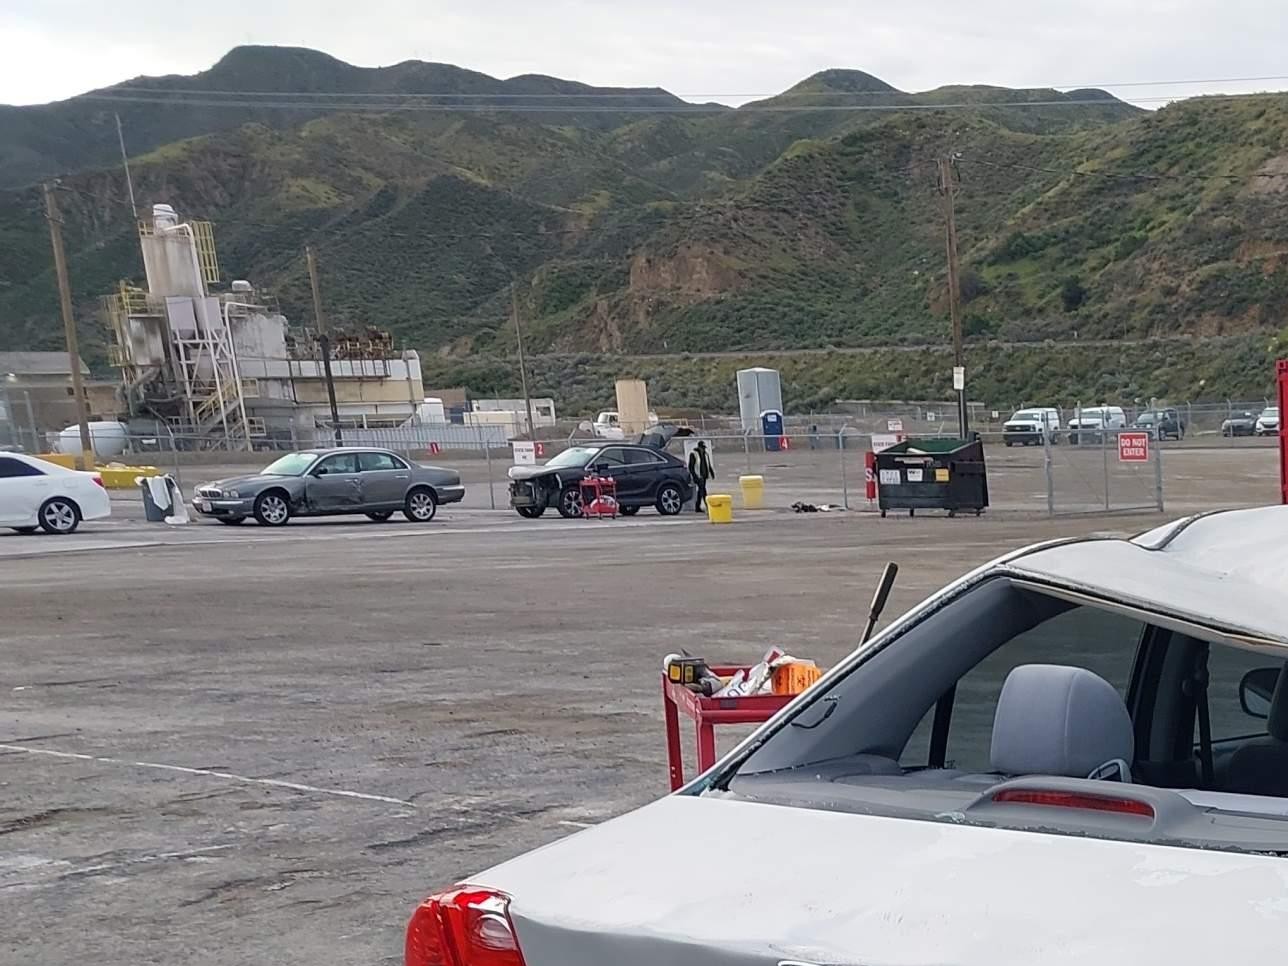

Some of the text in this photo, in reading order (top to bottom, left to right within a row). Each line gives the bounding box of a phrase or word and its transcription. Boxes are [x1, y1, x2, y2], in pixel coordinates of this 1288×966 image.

[1121, 438, 1146, 447] DO NOT
[1123, 447, 1145, 456] ENTER
